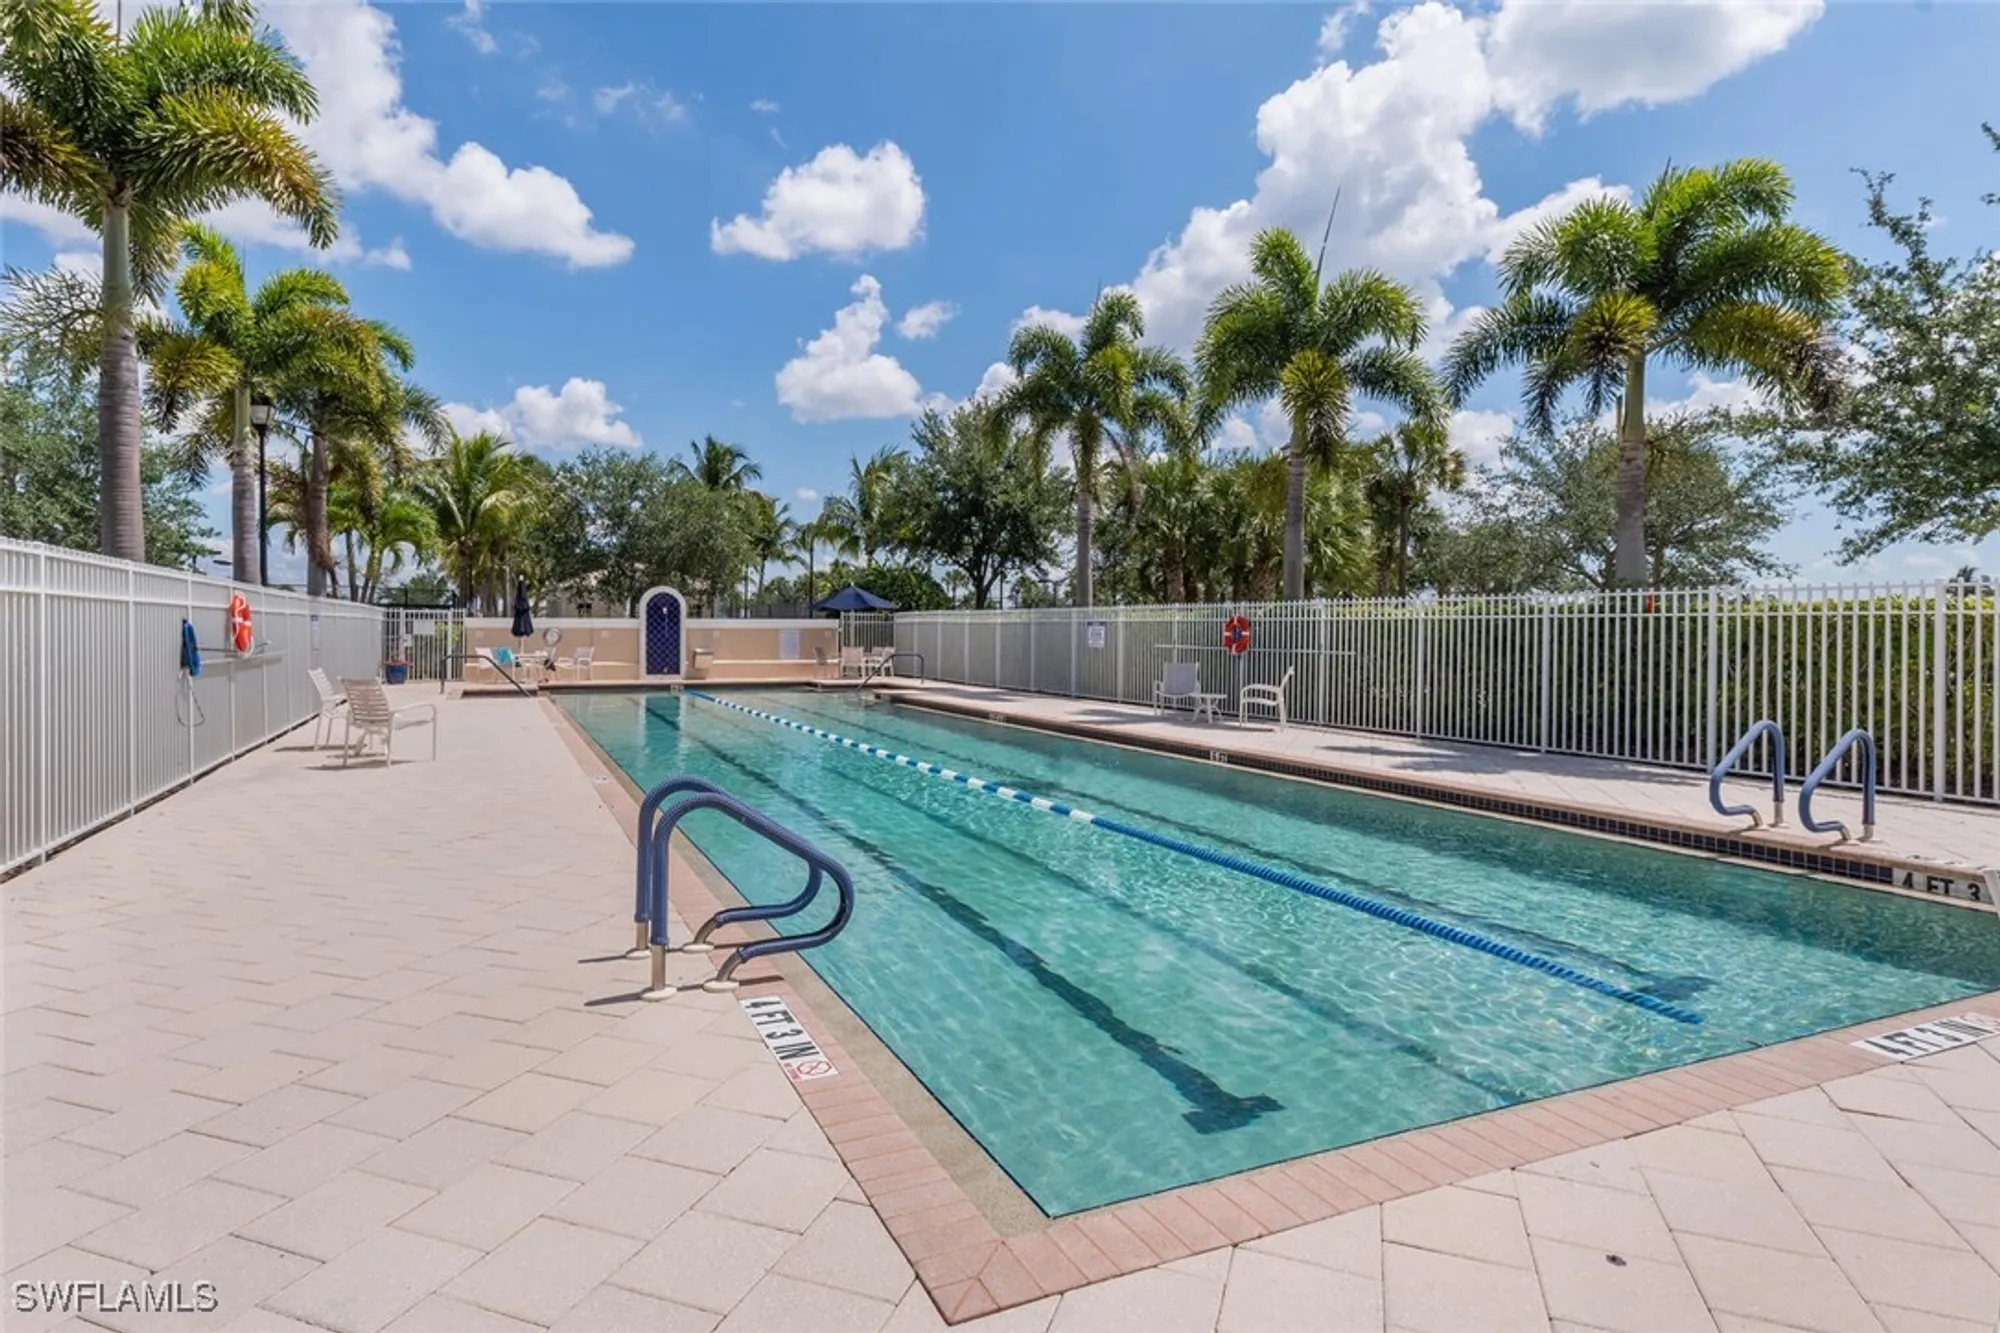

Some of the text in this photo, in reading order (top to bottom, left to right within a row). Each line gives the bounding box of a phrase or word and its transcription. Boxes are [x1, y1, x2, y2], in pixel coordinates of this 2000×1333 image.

[1926, 875, 1955, 895] FT
[751, 1010, 796, 1025] FT
[765, 1029, 804, 1040] 3
[773, 1041, 821, 1060] IN
